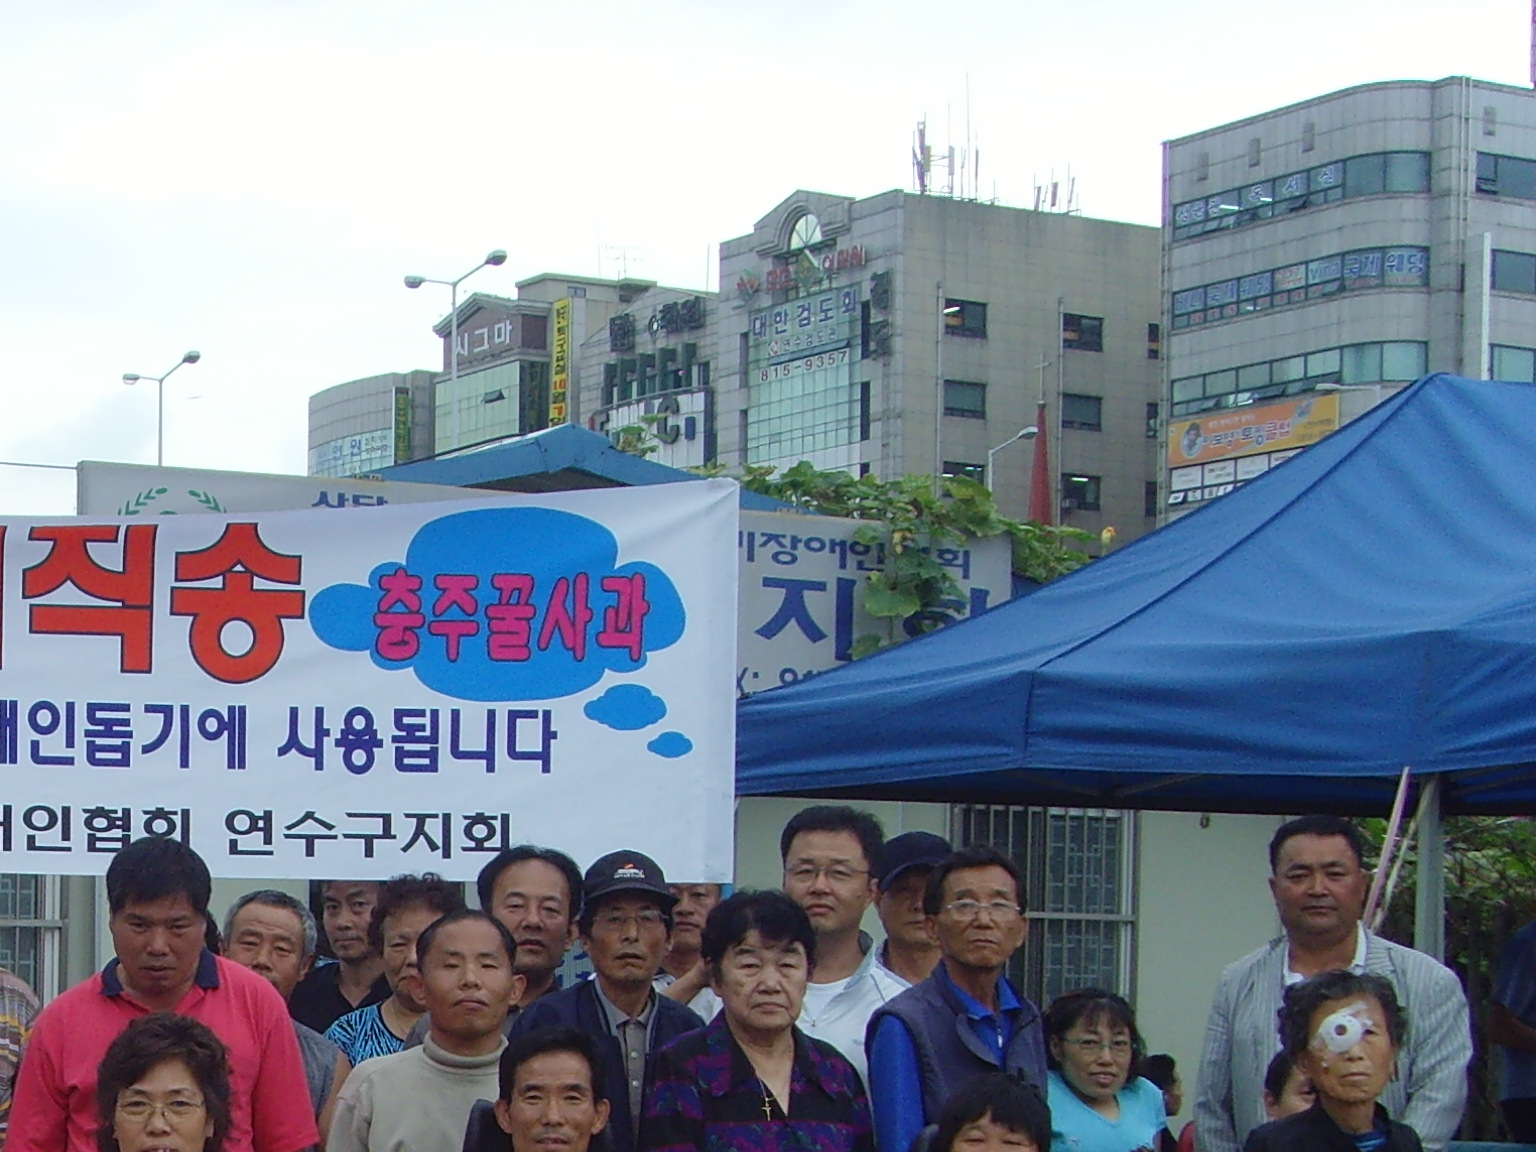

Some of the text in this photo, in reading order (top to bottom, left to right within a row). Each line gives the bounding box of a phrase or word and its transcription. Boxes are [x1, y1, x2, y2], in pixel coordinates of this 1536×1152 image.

[456, 320, 513, 356] 시그마
[752, 288, 856, 338] 대한검도회
[761, 351, 847, 381] 815-9357
[739, 531, 970, 580] 장애인회
[373, 567, 650, 662] 충주꿀사과
[276, 706, 557, 775] 사용됩니다
[225, 807, 513, 858] 연수구지회
